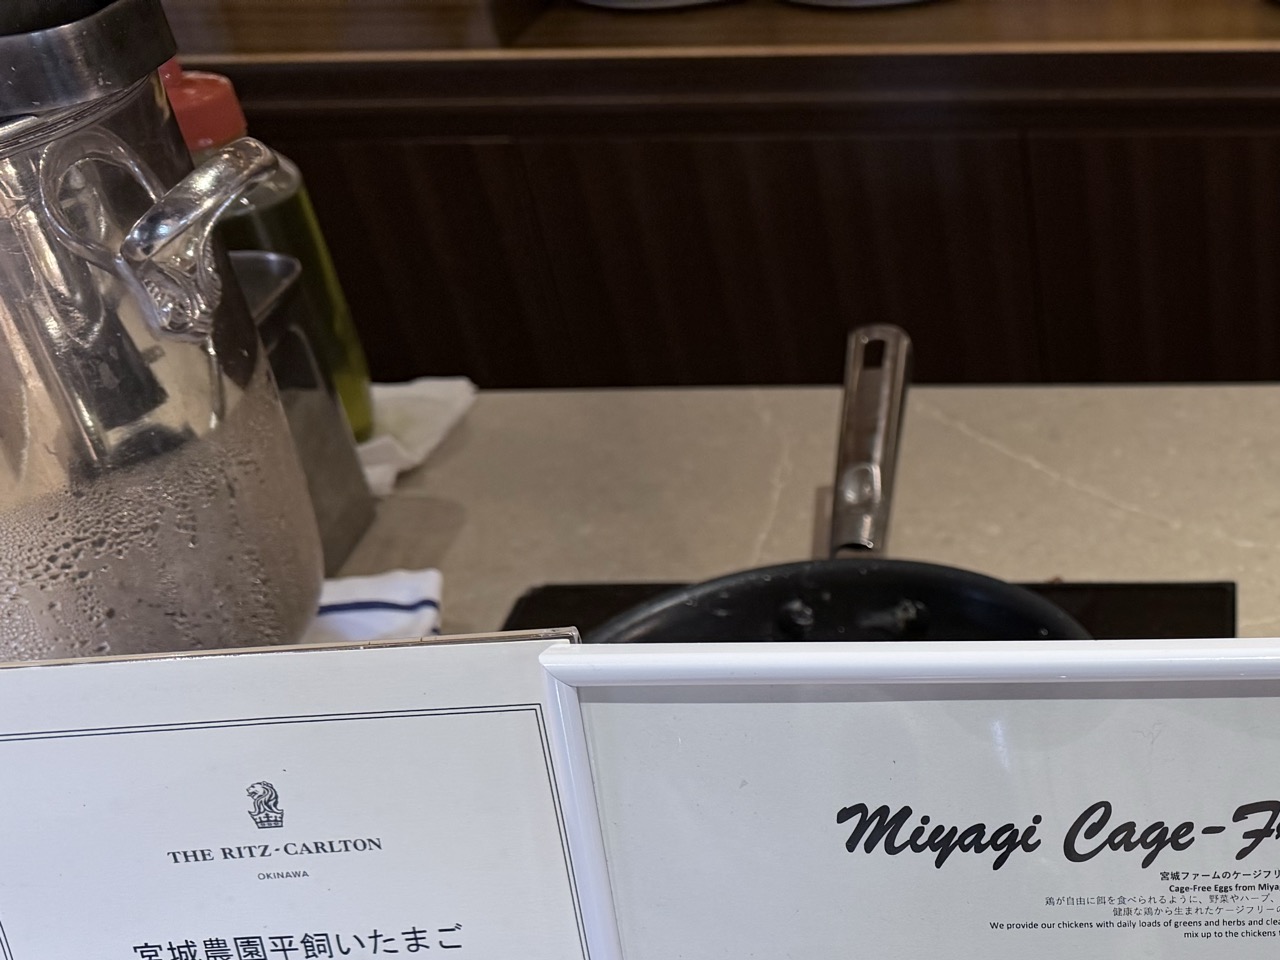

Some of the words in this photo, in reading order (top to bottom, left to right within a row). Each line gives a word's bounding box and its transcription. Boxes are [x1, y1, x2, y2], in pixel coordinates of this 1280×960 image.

[837, 803, 1042, 870] Miyagi
[167, 849, 214, 863] THE
[220, 838, 382, 859] RITZ-CARLTON
[258, 871, 309, 880] OKINAWA
[1169, 885, 1211, 894] Cage-Free
[1214, 884, 1233, 893] Eggs
